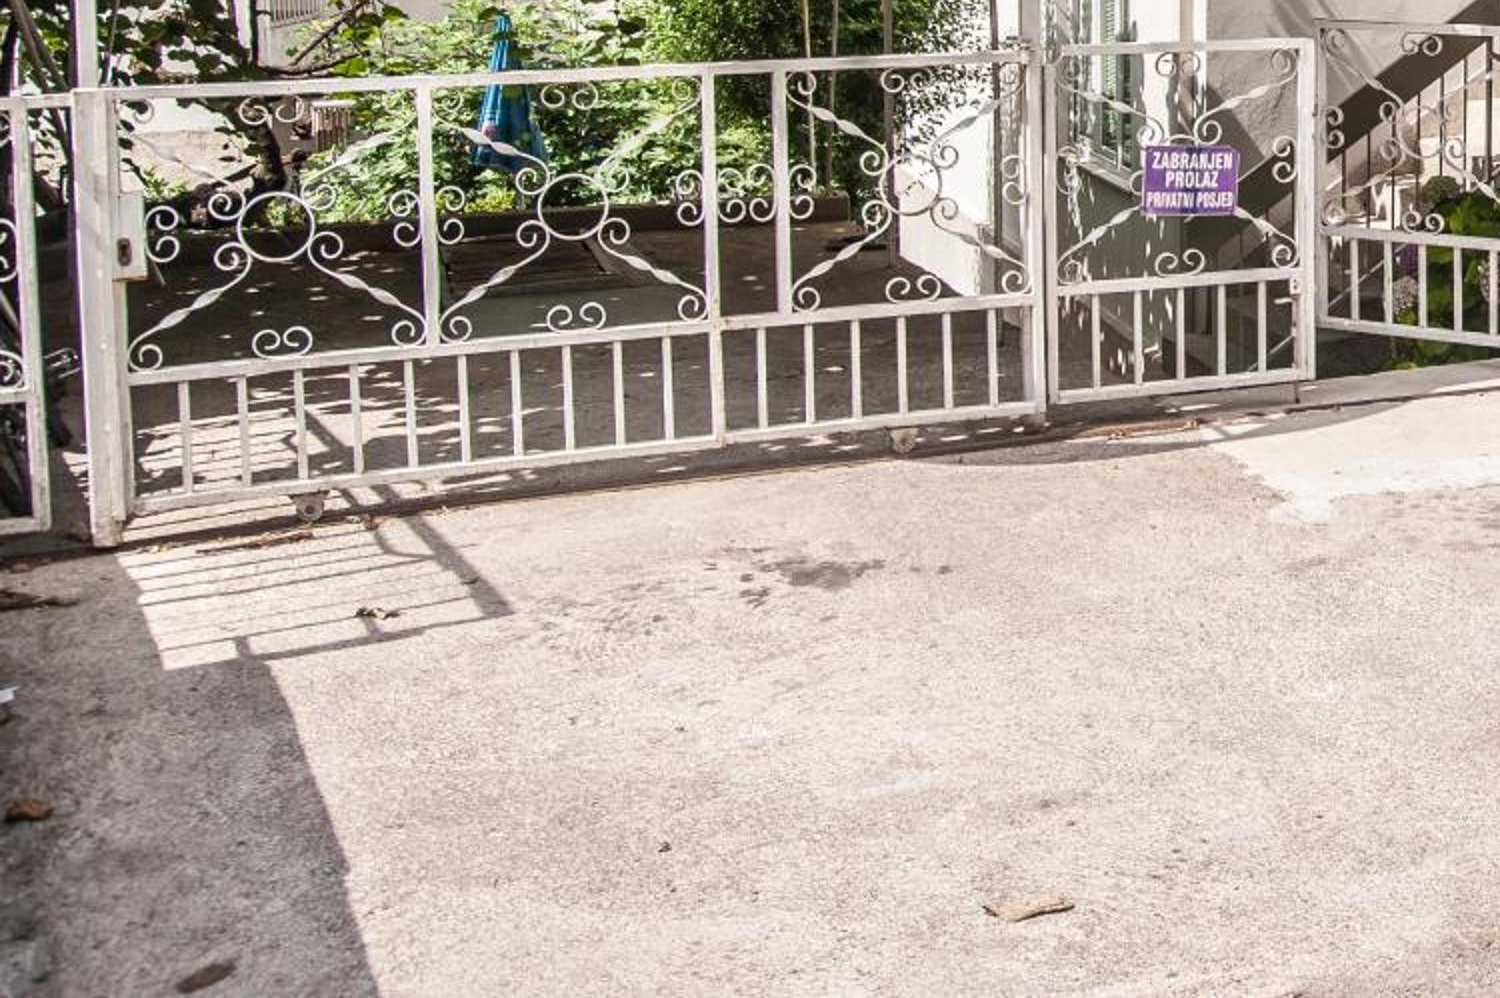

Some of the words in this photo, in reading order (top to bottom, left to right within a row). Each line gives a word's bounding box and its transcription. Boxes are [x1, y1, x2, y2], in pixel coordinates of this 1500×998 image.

[1152, 151, 1233, 170] ZABRANJEN
[1165, 169, 1219, 189] PROLAZ
[1146, 191, 1195, 209] PRIVATNI
[1196, 191, 1233, 208] POSJED
